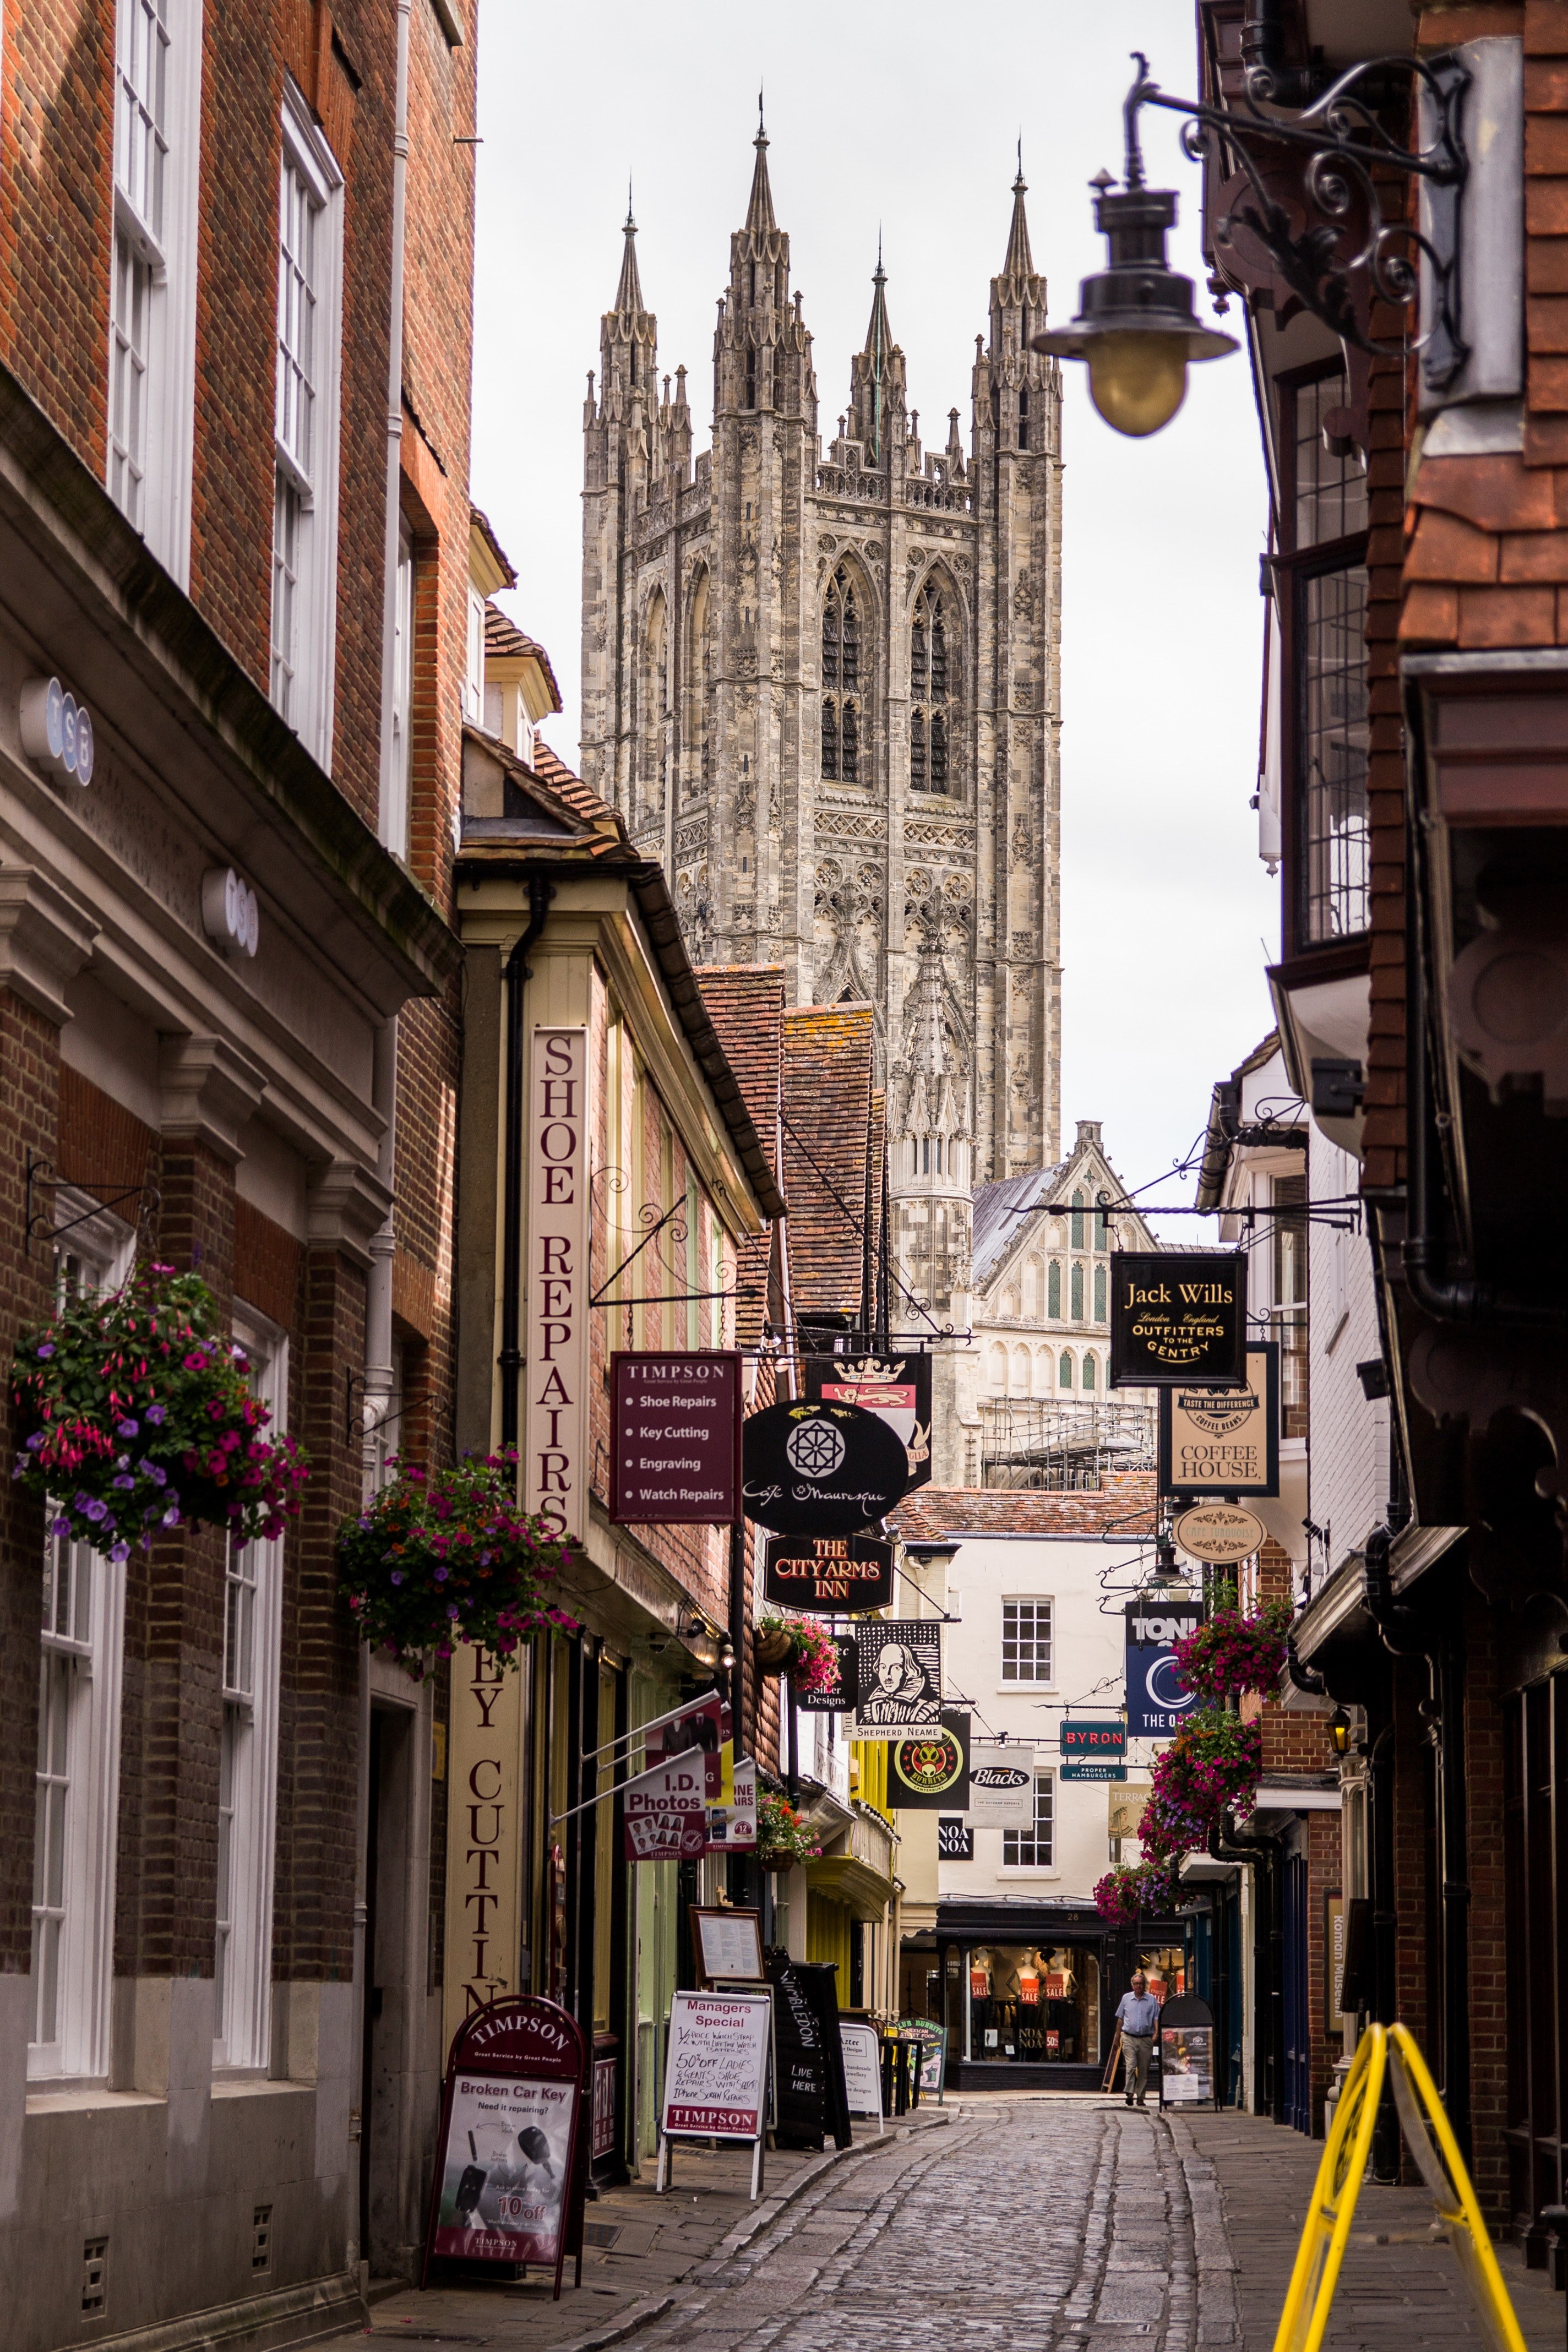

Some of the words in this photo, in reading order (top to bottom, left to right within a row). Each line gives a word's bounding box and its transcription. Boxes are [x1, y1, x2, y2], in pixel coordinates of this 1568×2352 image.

[52, 696, 88, 767] TSB
[540, 1037, 576, 1205] SHOE
[1124, 1283, 1172, 1309] Jack
[1178, 1283, 1233, 1304] Wills
[1137, 1311, 1170, 1322] London
[1183, 1313, 1219, 1326] England
[1133, 1325, 1224, 1336] OUTFITTERS
[1147, 1341, 1208, 1358] GENTRY
[628, 1365, 724, 1379] TIMPSON
[536, 1237, 574, 1540] REPAIRS
[640, 1396, 670, 1407] Shoe
[672, 1396, 716, 1409] Repairs
[1184, 1399, 1201, 1408] TASTE
[1217, 1399, 1254, 1408] DIFFERENCE
[1196, 1415, 1219, 1430] COFFEE
[1222, 1415, 1242, 1430] BEANS
[640, 1427, 662, 1440] Key
[665, 1427, 709, 1440] Cutting
[1182, 1446, 1257, 1460] COFFEE
[640, 1458, 701, 1471] Engraving
[640, 1489, 677, 1500] Watch
[680, 1489, 724, 1502] Repairs
[742, 1480, 783, 1506] Café
[792, 1483, 886, 1516] Mauresque
[1210, 1527, 1254, 1538] TURQUOISE
[813, 1539, 848, 1559] THE
[775, 1559, 825, 1578] CITY
[825, 1561, 880, 1581] ARMS
[814, 1580, 849, 1599] INN
[1132, 1618, 1196, 1640] TONI
[470, 1645, 503, 1727] EY
[814, 1686, 841, 1694] Siler
[808, 1695, 846, 1707] Designs
[843, 1713, 852, 1735] THE
[1142, 1714, 1164, 1727] THE
[858, 1727, 902, 1736] SHEPHERD
[907, 1727, 938, 1736] NEAME
[1066, 1733, 1122, 1744] BYRON
[665, 1774, 700, 1791] I.D.
[912, 1772, 946, 1784] BURRITO
[974, 1769, 1025, 1784] Blacks
[629, 1793, 700, 1811] Photos
[1112, 1792, 1152, 1804] TERRAC
[938, 1826, 969, 1838] NOA
[938, 1839, 969, 1852] NOA
[461, 1760, 505, 2018] CUTTIN
[973, 1987, 987, 1995] SALE
[1022, 1993, 1038, 2001] SALE
[1047, 1989, 1063, 1997] SALE
[1155, 1994, 1165, 2004] LE
[687, 2000, 751, 2014] Managers
[780, 1970, 815, 2048] WIMBLEDON
[695, 2015, 744, 2027] Special
[897, 2020, 912, 2029] LUB
[916, 2020, 943, 2035] BURRITO
[471, 2015, 570, 2051] TIMPSON
[733, 2033, 754, 2041] STRAP
[1019, 2028, 1043, 2038] NOA
[1019, 2039, 1043, 2048] NOA
[706, 2047, 749, 2055] BATTERIES
[700, 2059, 718, 2068] OFF
[719, 2057, 754, 2073] LADIES
[792, 2065, 813, 2078] LIVE
[684, 2069, 715, 2081] GENTS
[718, 2071, 742, 2081] SHOE
[675, 2079, 712, 2088] REPAIRS
[792, 2080, 816, 2092] HERE
[461, 2081, 509, 2096] Broken
[514, 2086, 537, 2098] Car
[541, 2087, 567, 2104] Key
[478, 2102, 499, 2111] Need
[509, 2105, 548, 2115] repairing?
[672, 2109, 753, 2126] TIMPSON
[524, 2205, 547, 2220] off
[475, 2237, 517, 2247] TIMPSON
